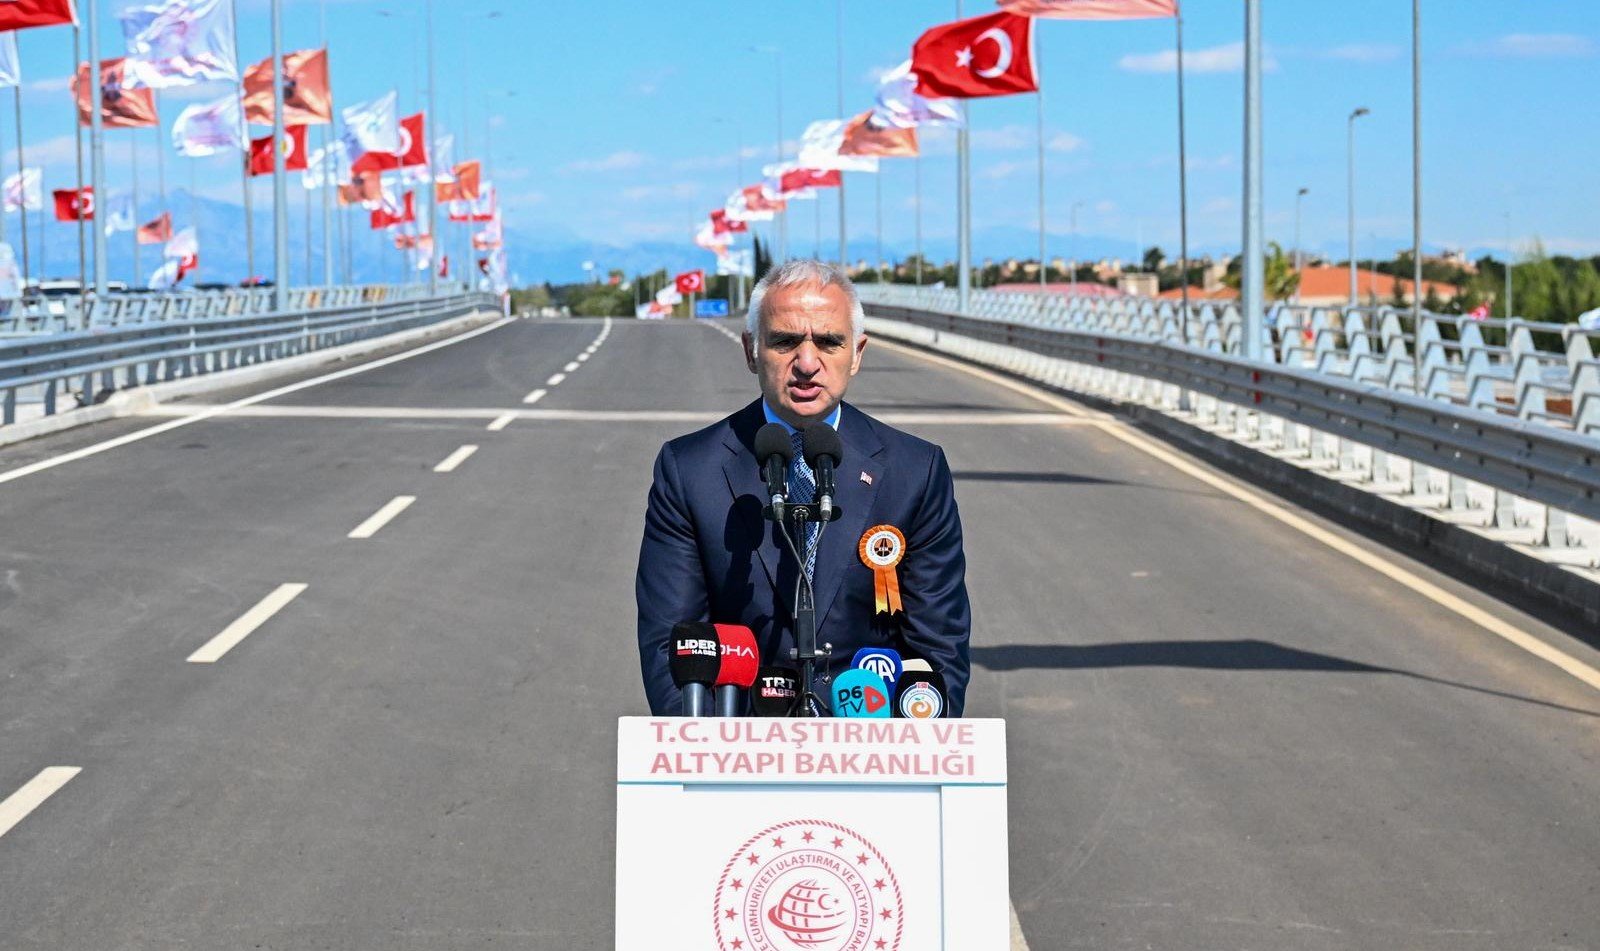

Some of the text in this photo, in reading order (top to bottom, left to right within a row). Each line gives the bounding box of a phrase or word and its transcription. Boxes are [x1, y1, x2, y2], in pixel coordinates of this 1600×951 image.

[691, 649, 717, 657] HABER
[762, 677, 795, 689] TRT
[762, 687, 796, 698] HABER
[838, 686, 863, 703] D6
[840, 699, 864, 717] TV
[650, 721, 975, 749] T.C. ULAŞTIRMA VE
[650, 750, 975, 776] ALTYAPI BAKANLIĞI
[776, 854, 840, 872] ULAŞTIRMA
[841, 867, 855, 882] VE
[852, 882, 869, 928] ALTYAPI
